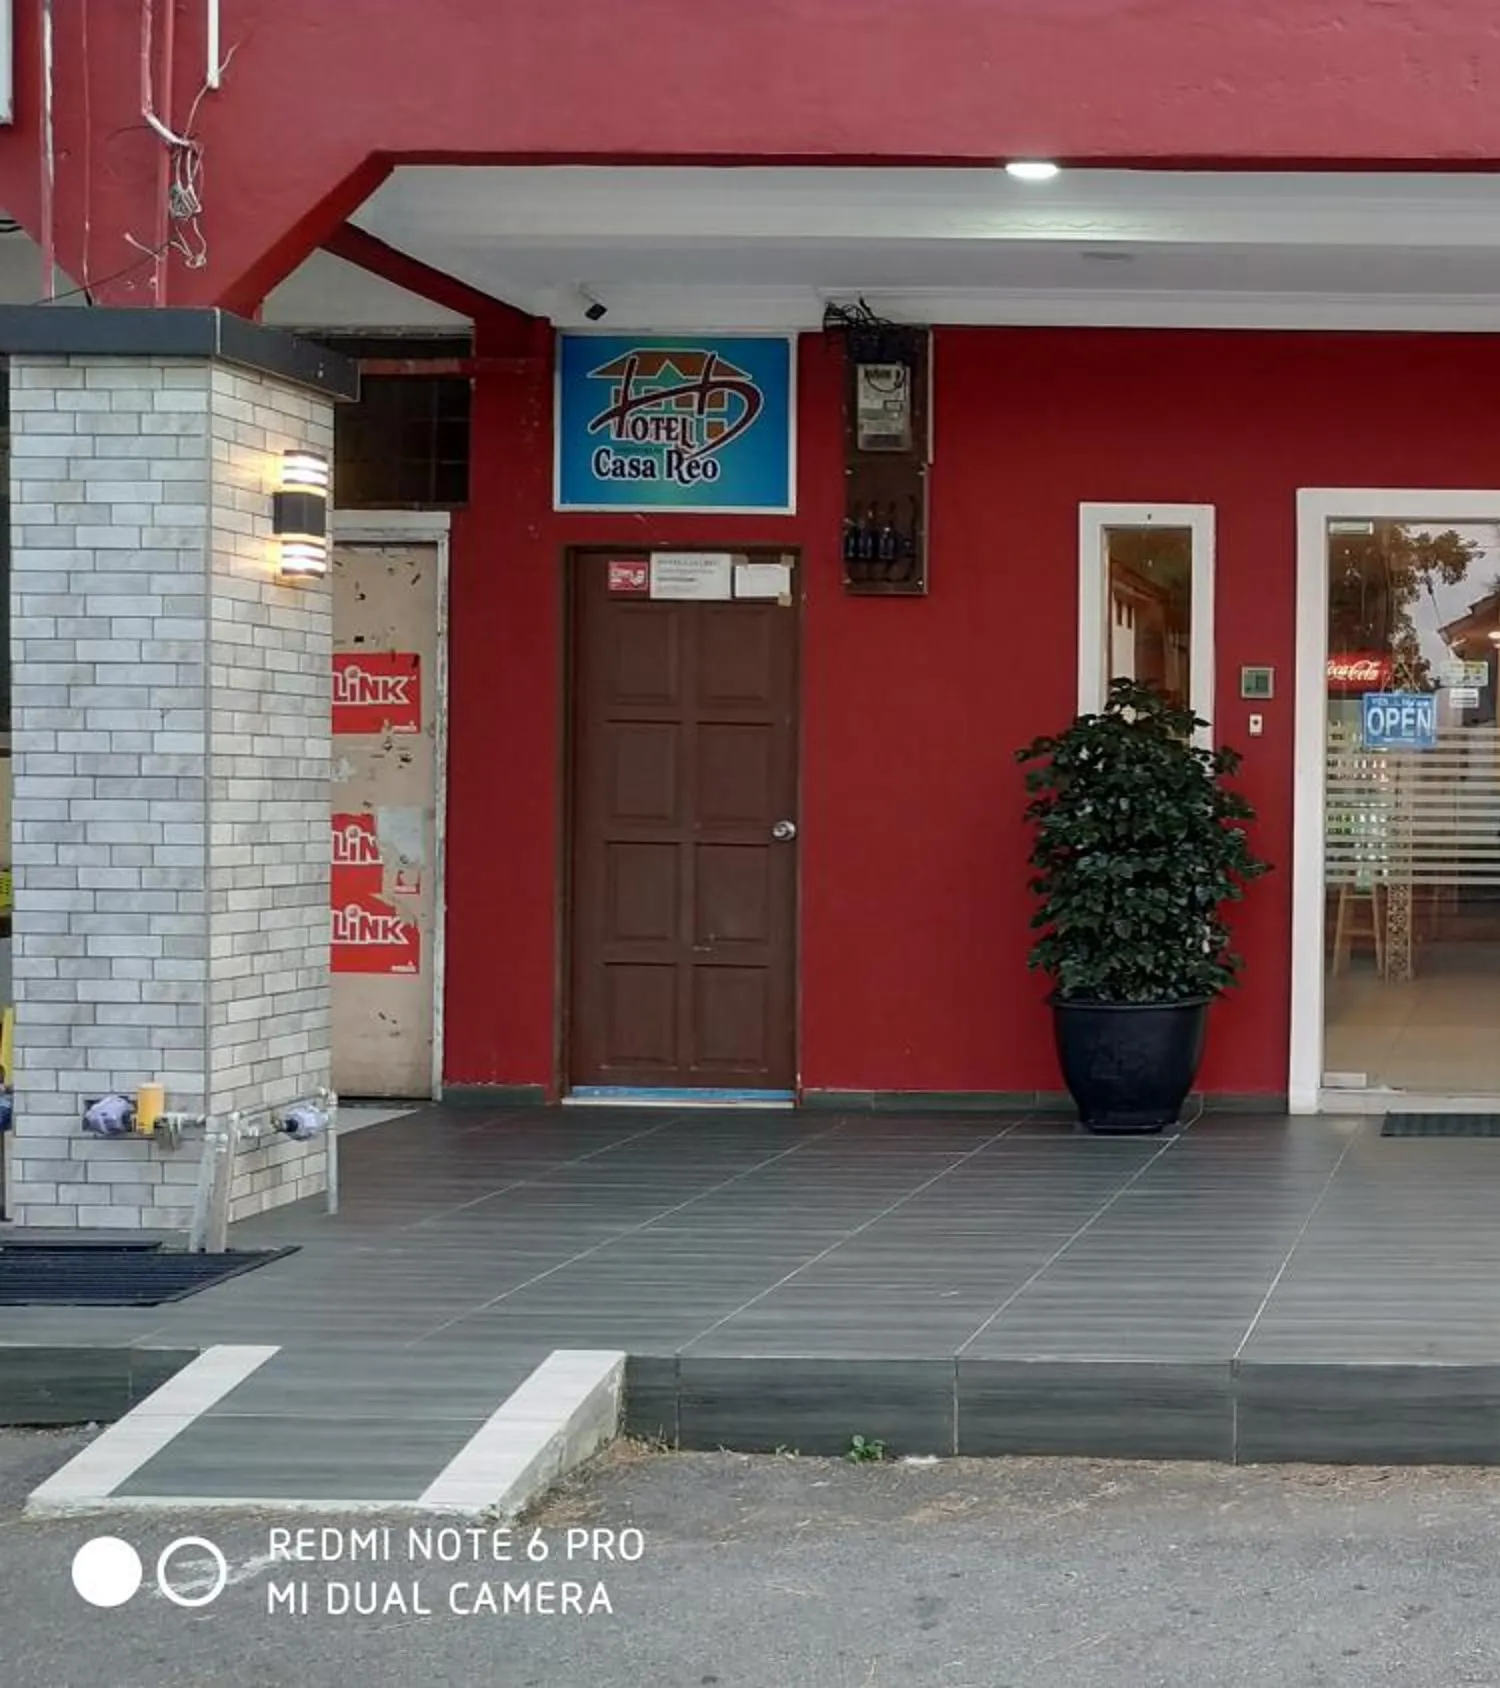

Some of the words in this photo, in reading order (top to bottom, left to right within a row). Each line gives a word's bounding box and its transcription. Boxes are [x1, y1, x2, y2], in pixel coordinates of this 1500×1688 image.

[593, 447, 657, 479] Casa
[665, 447, 719, 485] Reo
[1367, 707, 1431, 737] OPEN
